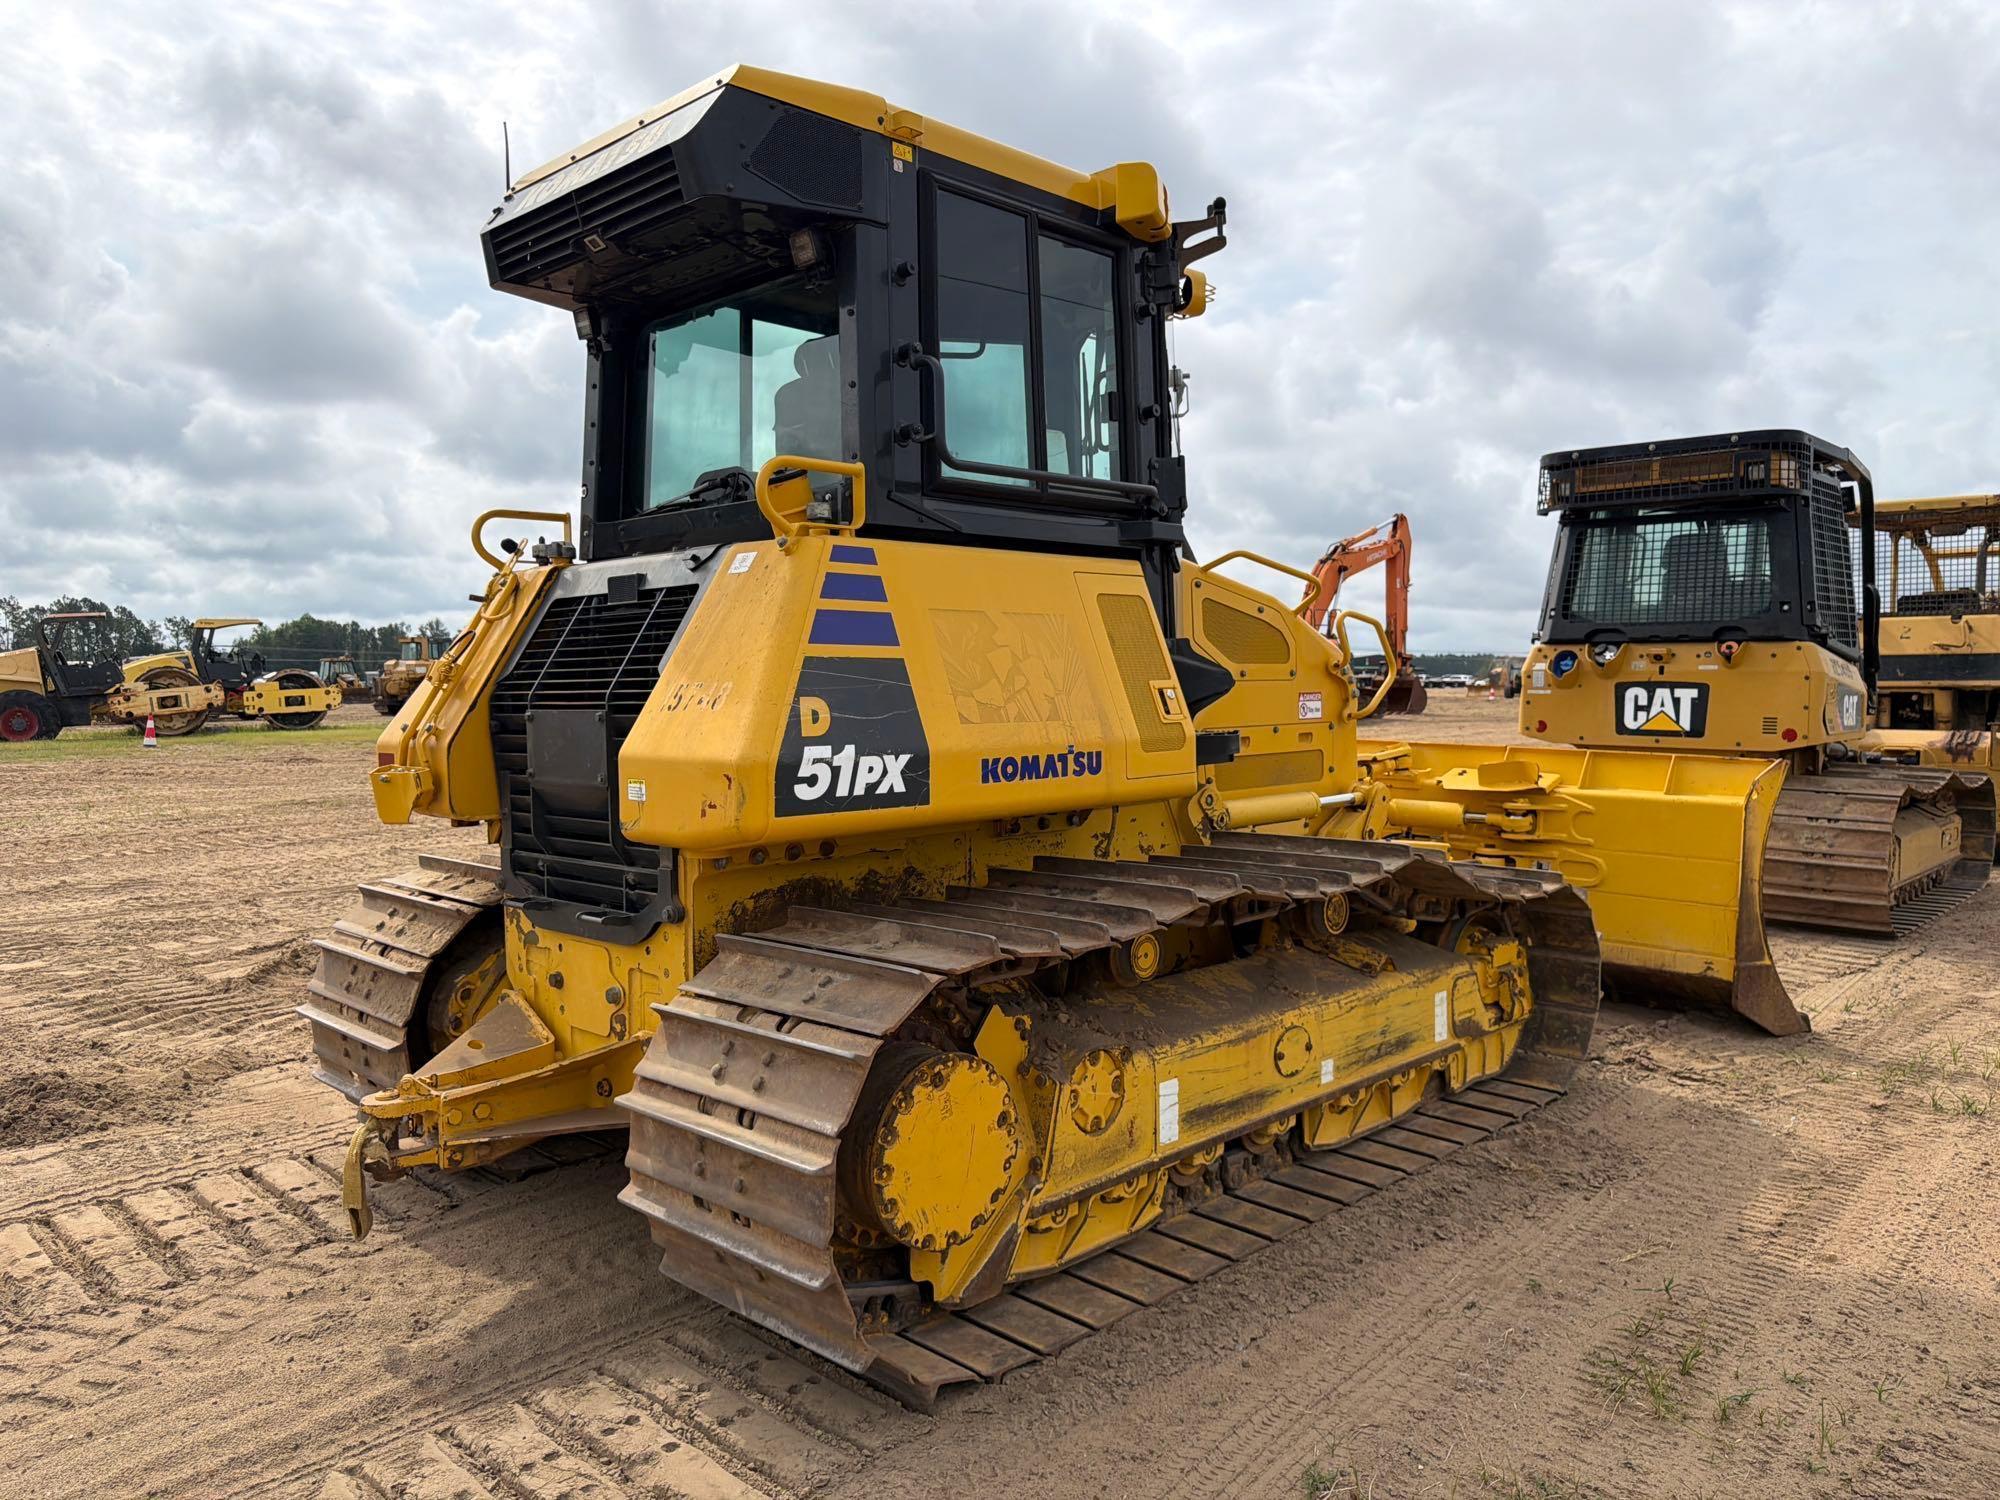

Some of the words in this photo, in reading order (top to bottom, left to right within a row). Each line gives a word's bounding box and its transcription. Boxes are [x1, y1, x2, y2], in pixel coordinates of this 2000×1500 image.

[800, 696, 831, 737] D
[1623, 687, 1698, 732] CAT
[1843, 694, 1858, 727] CAT
[793, 744, 914, 801] 51PX
[981, 745, 1102, 784] KOMATSU
